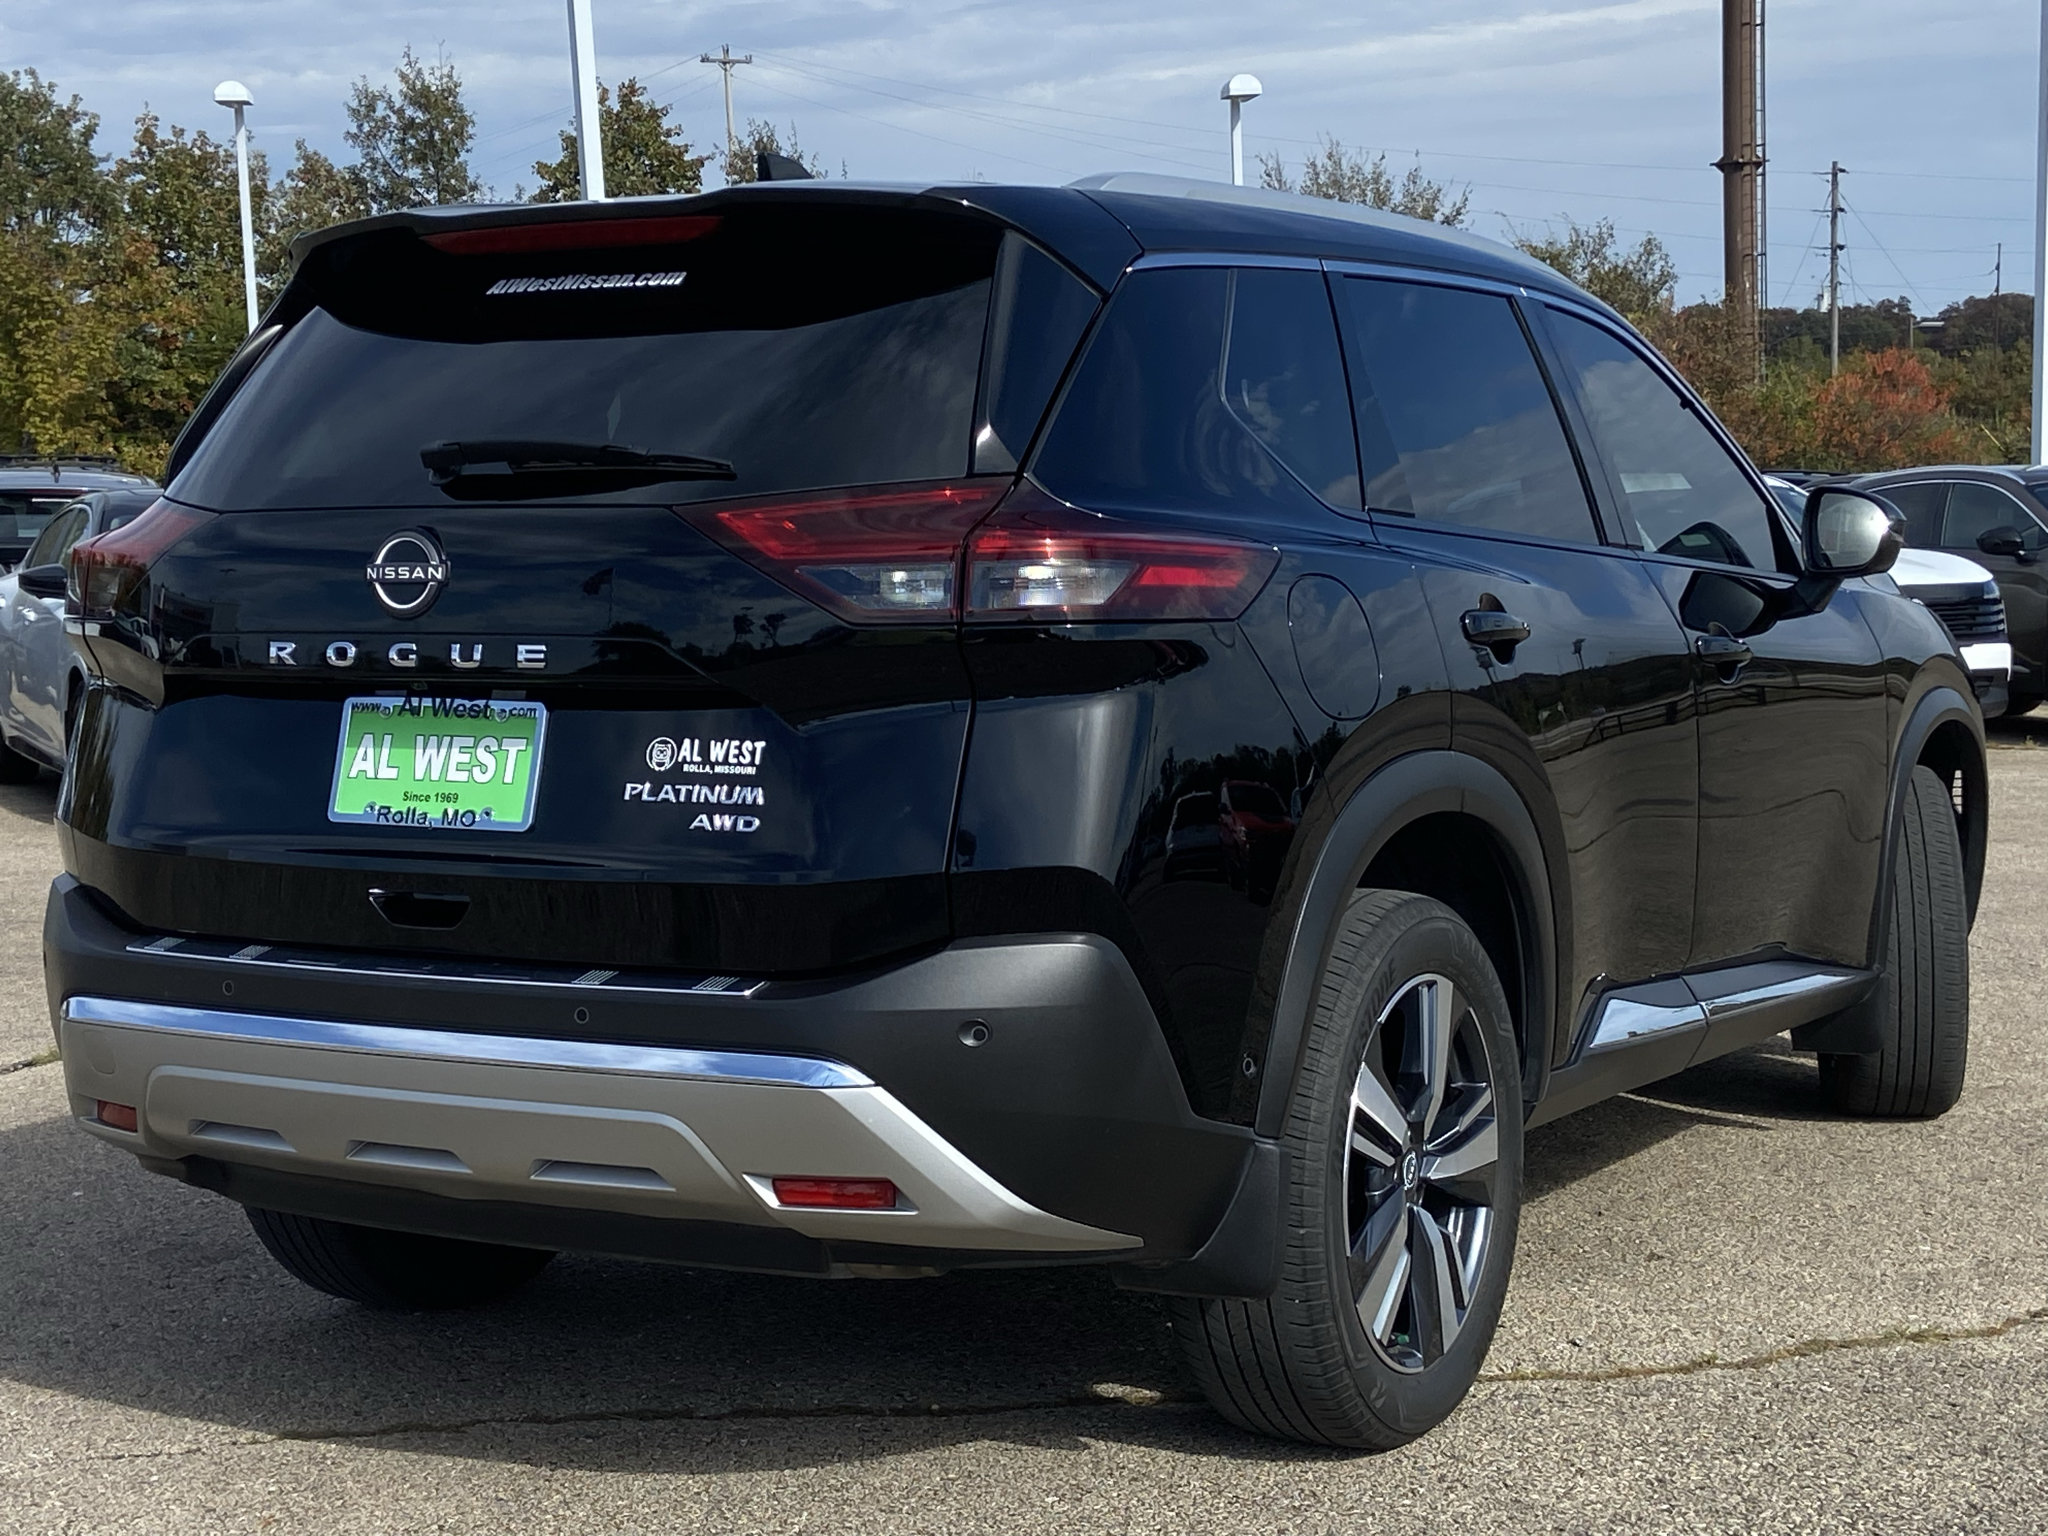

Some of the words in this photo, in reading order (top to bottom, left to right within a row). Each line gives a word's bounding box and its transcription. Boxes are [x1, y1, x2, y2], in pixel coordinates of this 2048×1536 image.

[486, 271, 688, 295] AlWestNissan.com
[366, 566, 443, 580] NISSAN
[268, 640, 548, 669] ROGUE
[432, 696, 491, 720] West
[348, 732, 399, 780] AL
[414, 733, 528, 784] WEST
[677, 737, 703, 763] AL
[709, 738, 767, 766] WEST
[683, 763, 714, 775] ROLLA,
[714, 765, 757, 775] MISSOURI
[402, 790, 431, 803] Since
[434, 792, 459, 804] 1969
[623, 781, 765, 806] PLATINUM
[376, 805, 433, 829] Rolla,
[441, 807, 477, 828] MO
[689, 813, 761, 833] AWD
